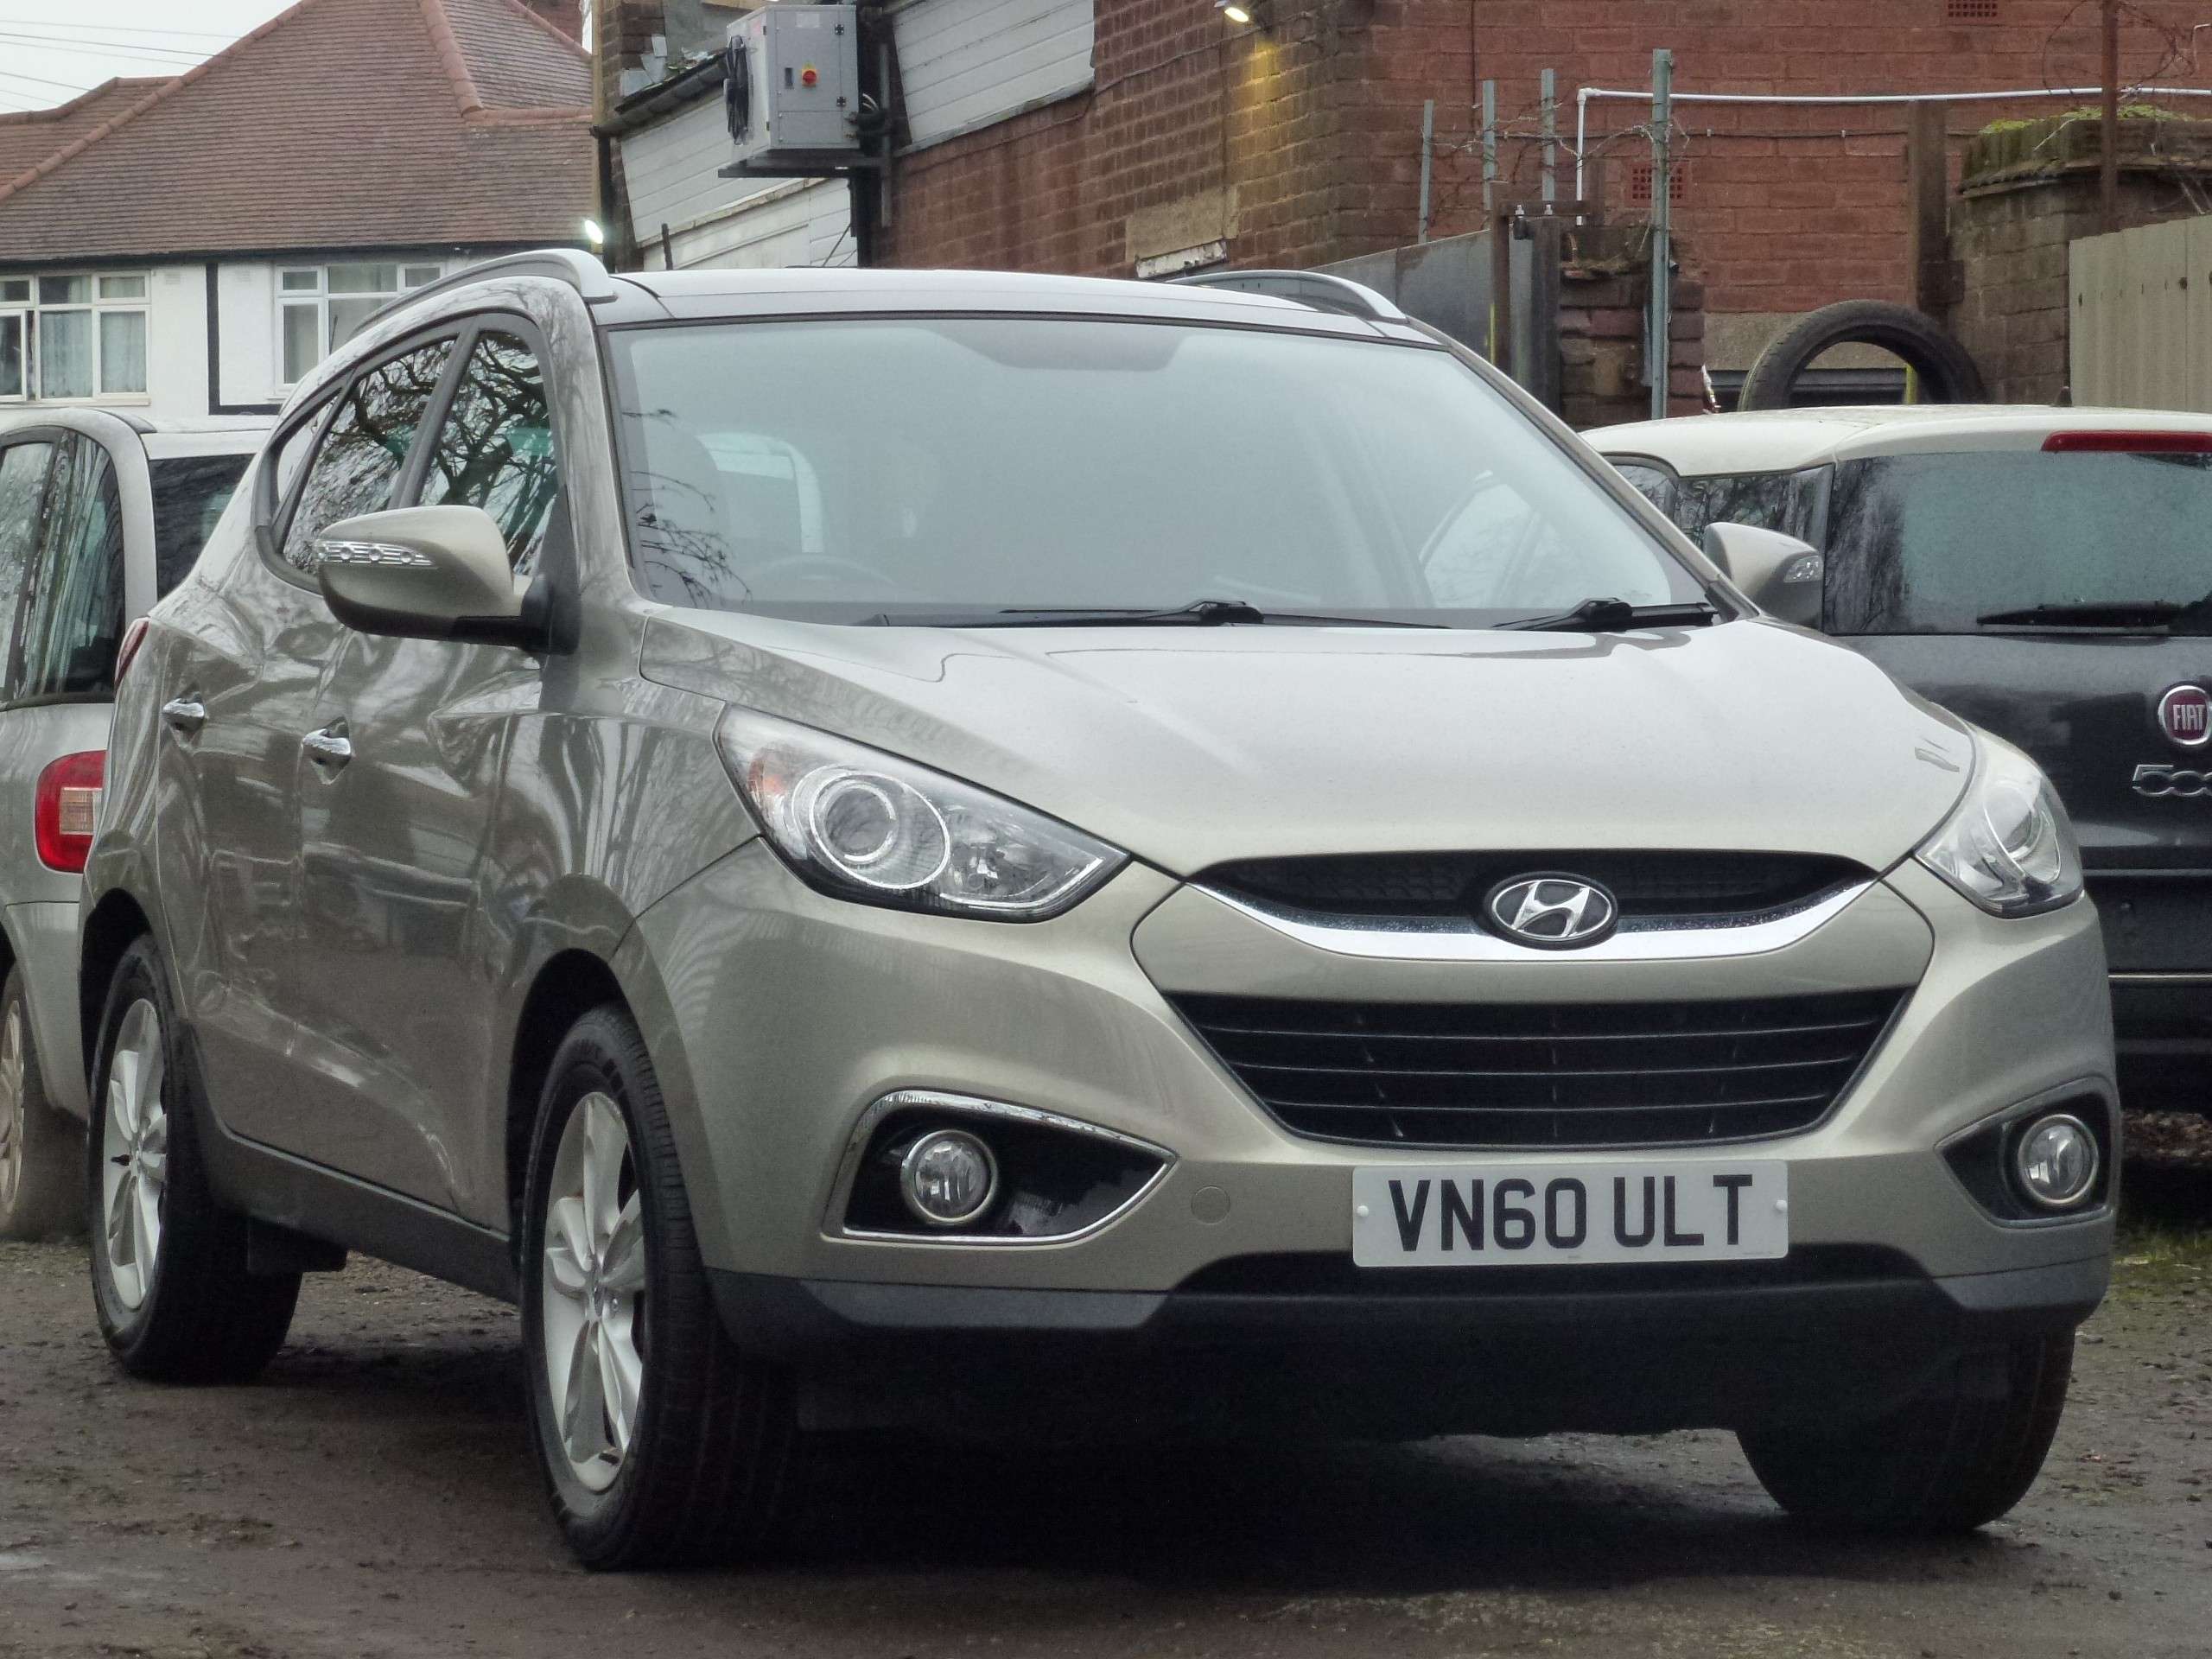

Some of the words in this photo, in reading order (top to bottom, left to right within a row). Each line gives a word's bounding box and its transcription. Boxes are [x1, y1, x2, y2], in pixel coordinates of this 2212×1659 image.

[2172, 704, 2205, 730] FIAT
[2132, 764, 2212, 797] 50
[1389, 1177, 1586, 1252] VN60
[1613, 1173, 1752, 1249] ULT
